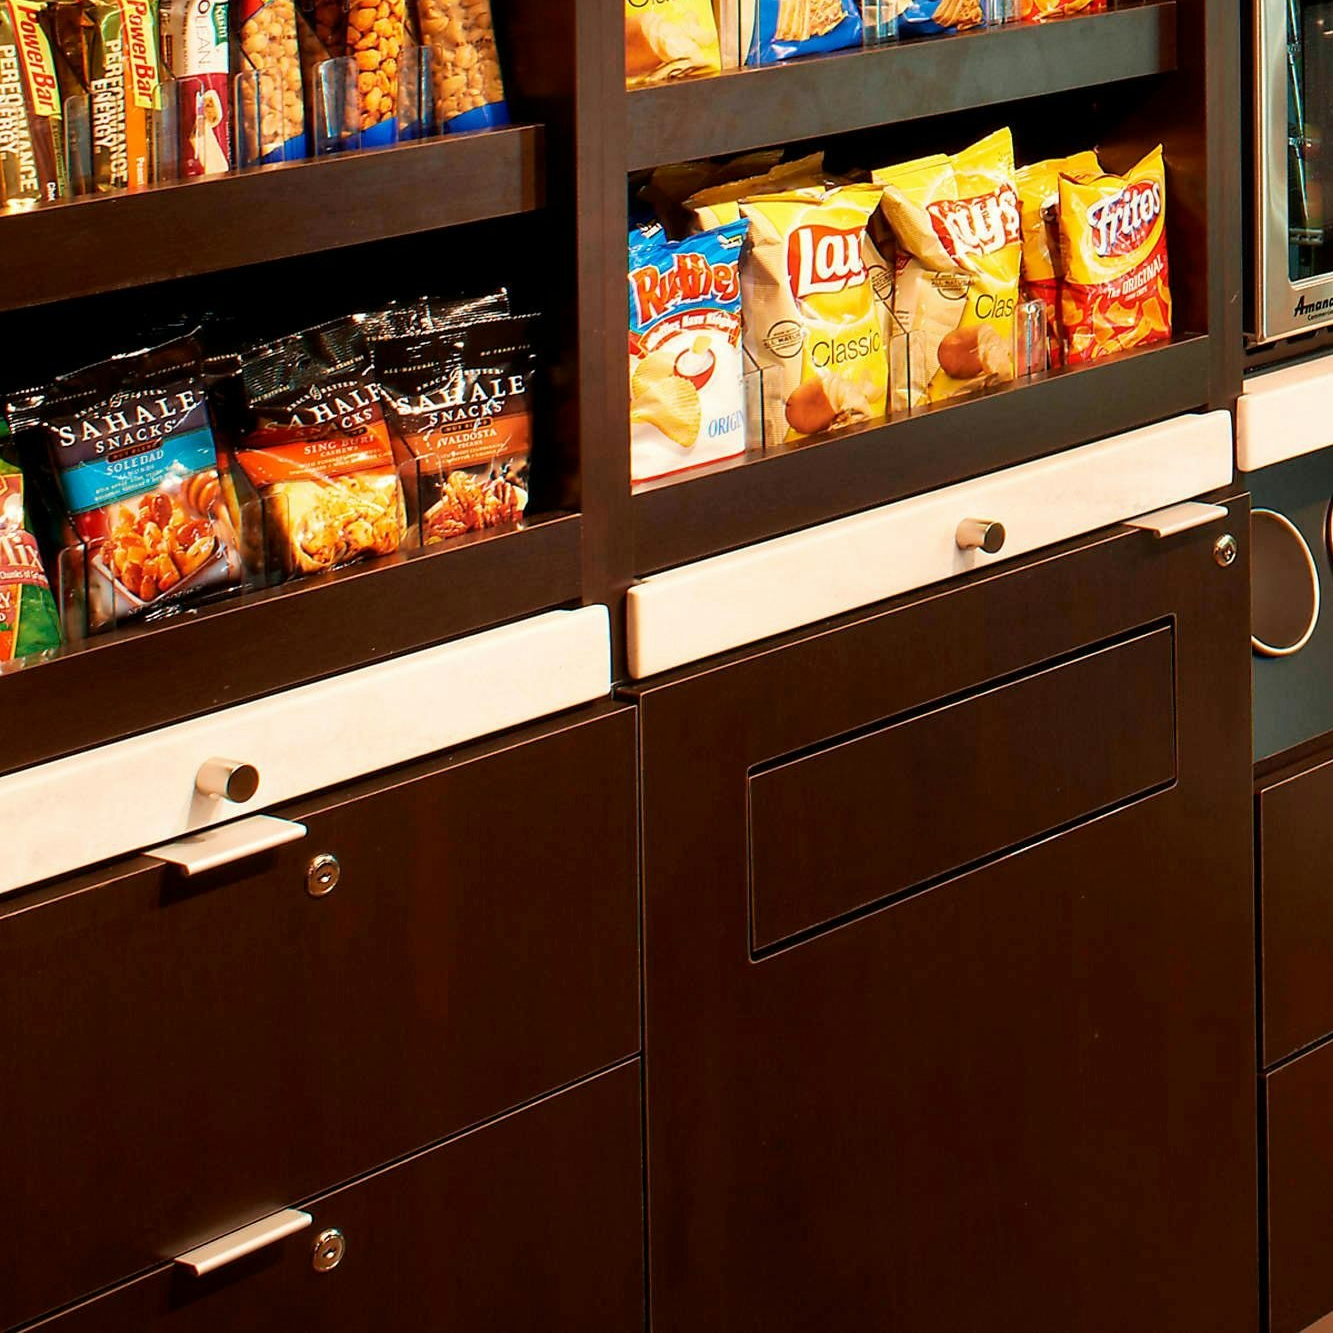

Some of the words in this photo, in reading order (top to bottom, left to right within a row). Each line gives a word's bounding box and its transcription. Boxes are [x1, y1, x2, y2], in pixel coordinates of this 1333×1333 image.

[17, 4, 57, 112] PowerBar
[1087, 182, 1163, 257] Fritos
[631, 253, 741, 326] Ruffles
[1122, 260, 1164, 298] ORIGINAL
[811, 328, 882, 370] Classic
[396, 374, 526, 416] SAHALE
[429, 400, 505, 427] SNACKS
[58, 390, 198, 447] SAHALE
[95, 420, 173, 454] SNACKS
[105, 449, 165, 476] SOLEDAD
